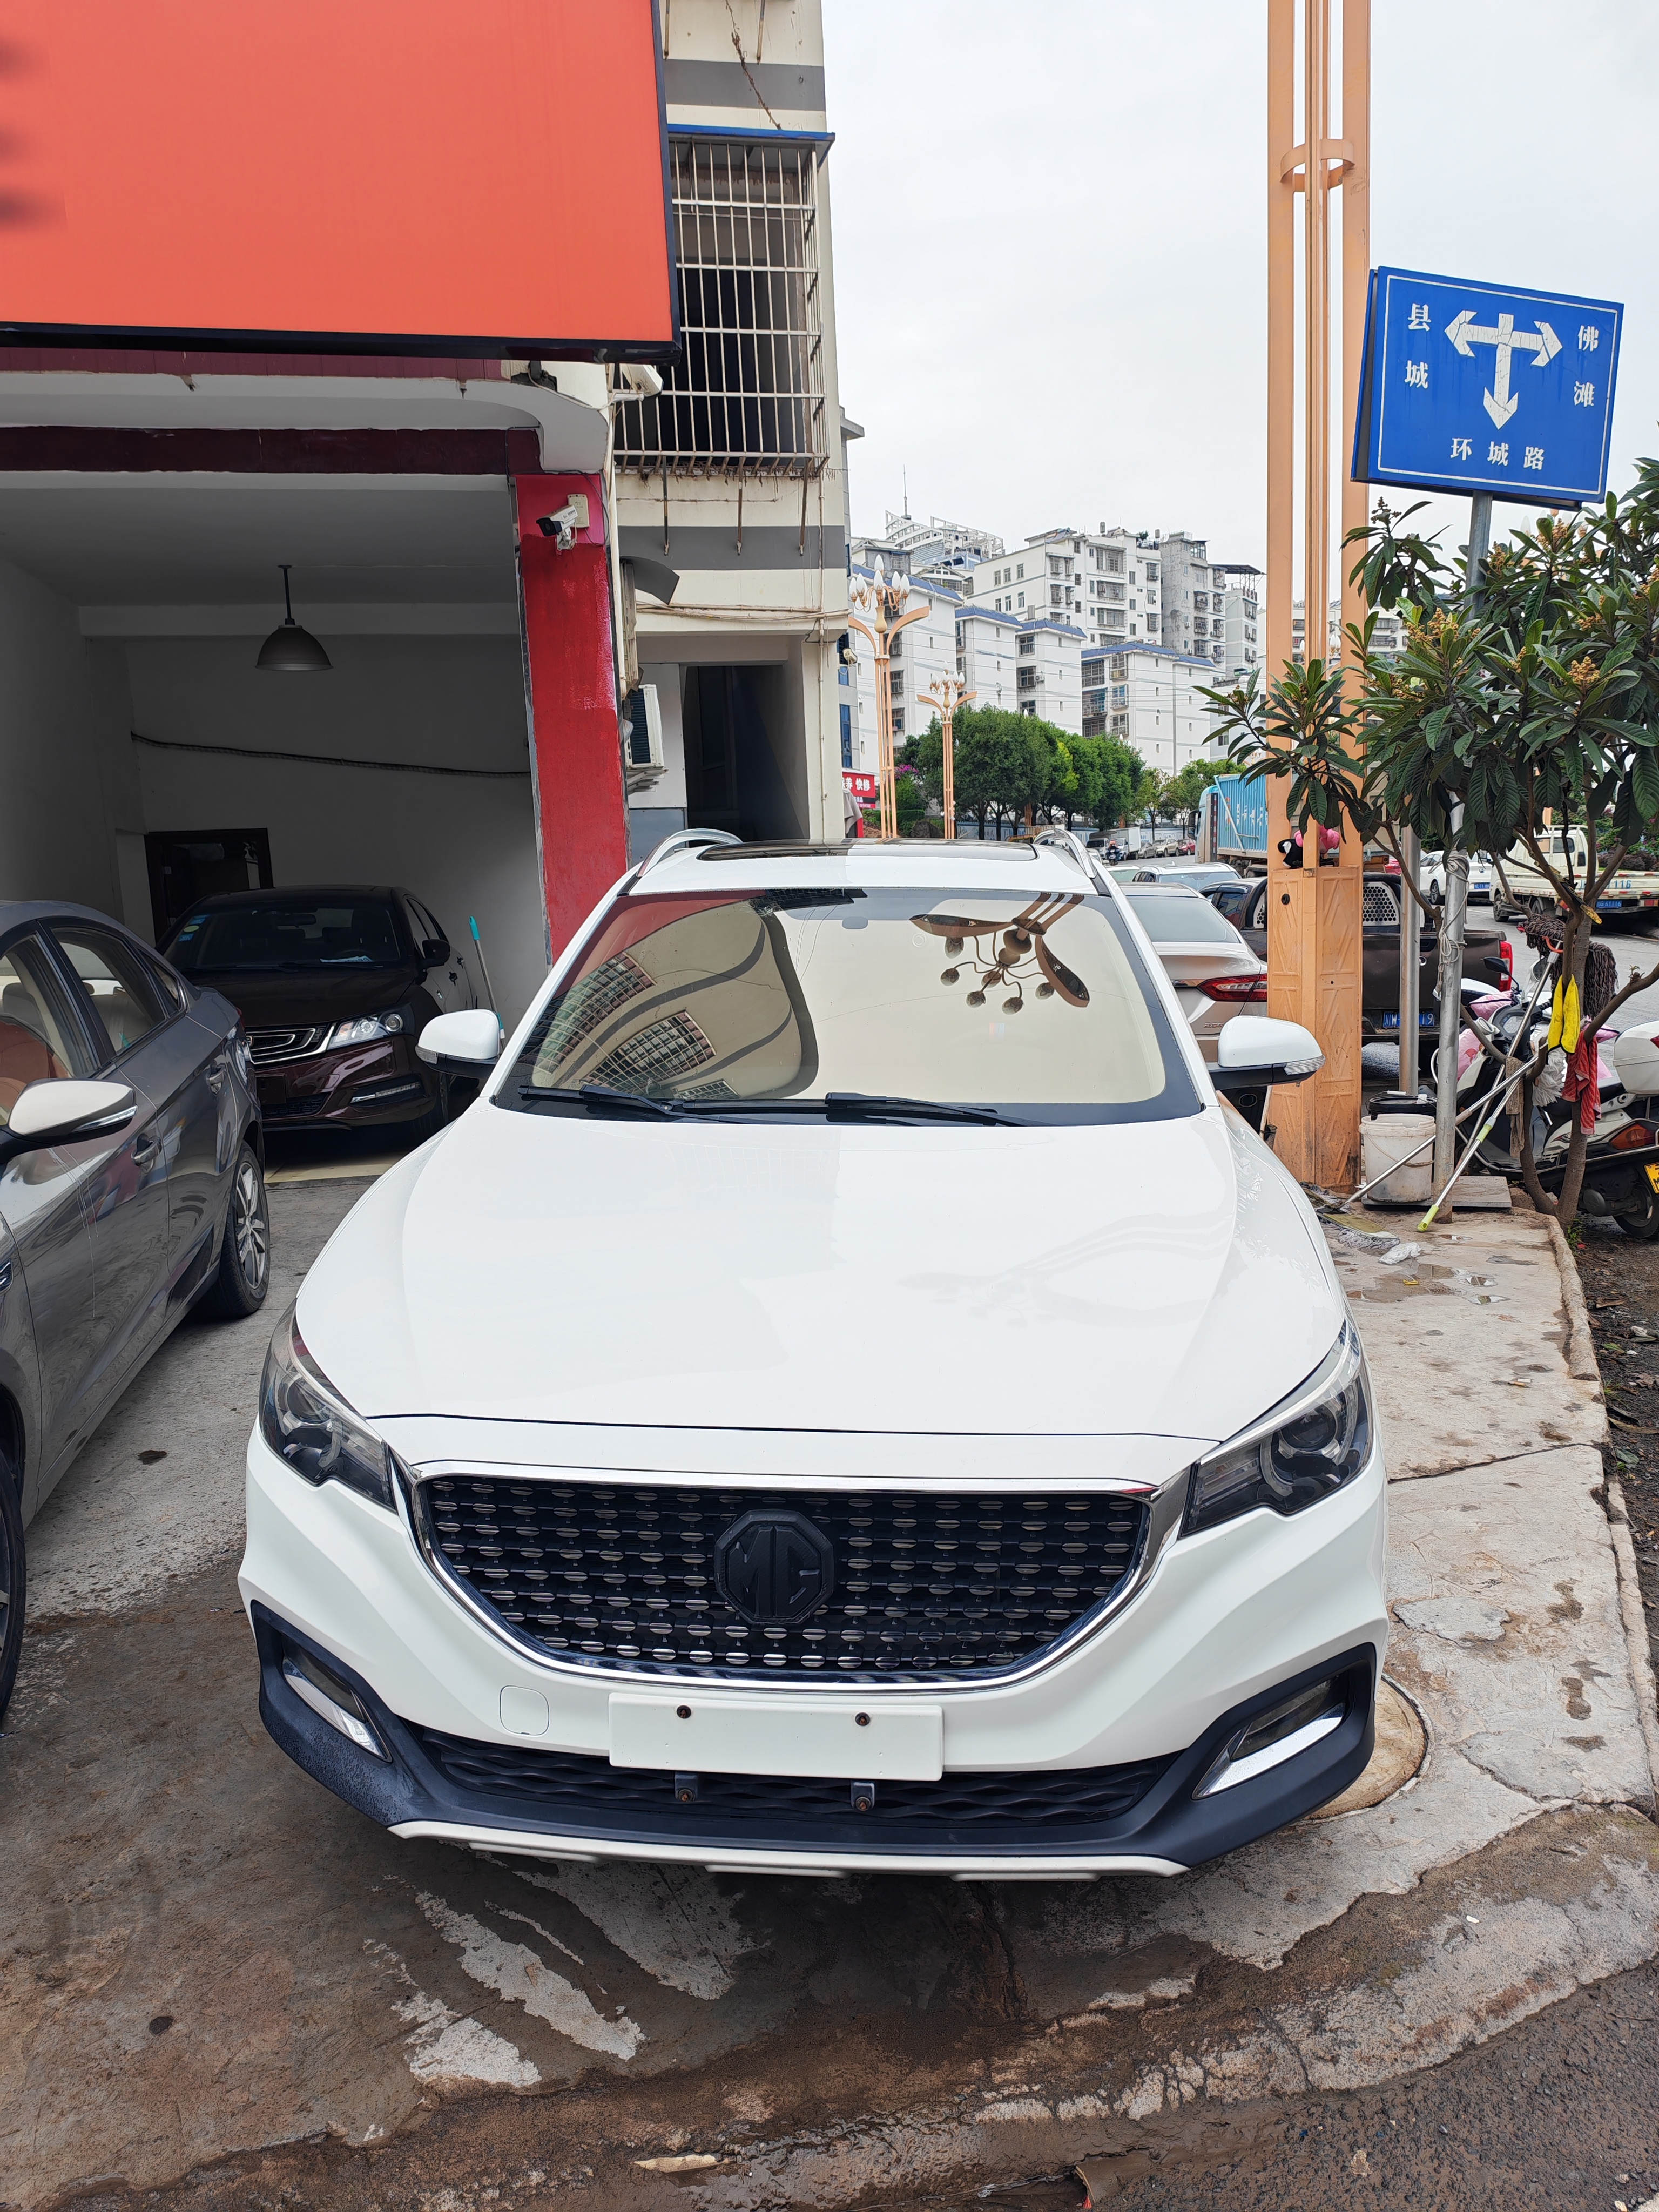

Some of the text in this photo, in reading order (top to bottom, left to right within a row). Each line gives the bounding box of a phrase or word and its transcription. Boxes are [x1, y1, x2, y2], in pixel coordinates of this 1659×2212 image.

[1404, 303, 1431, 389] 县城
[1574, 325, 1599, 407] 佛滩
[1450, 437, 1545, 470] 环城路
[728, 1526, 822, 1618] MG
